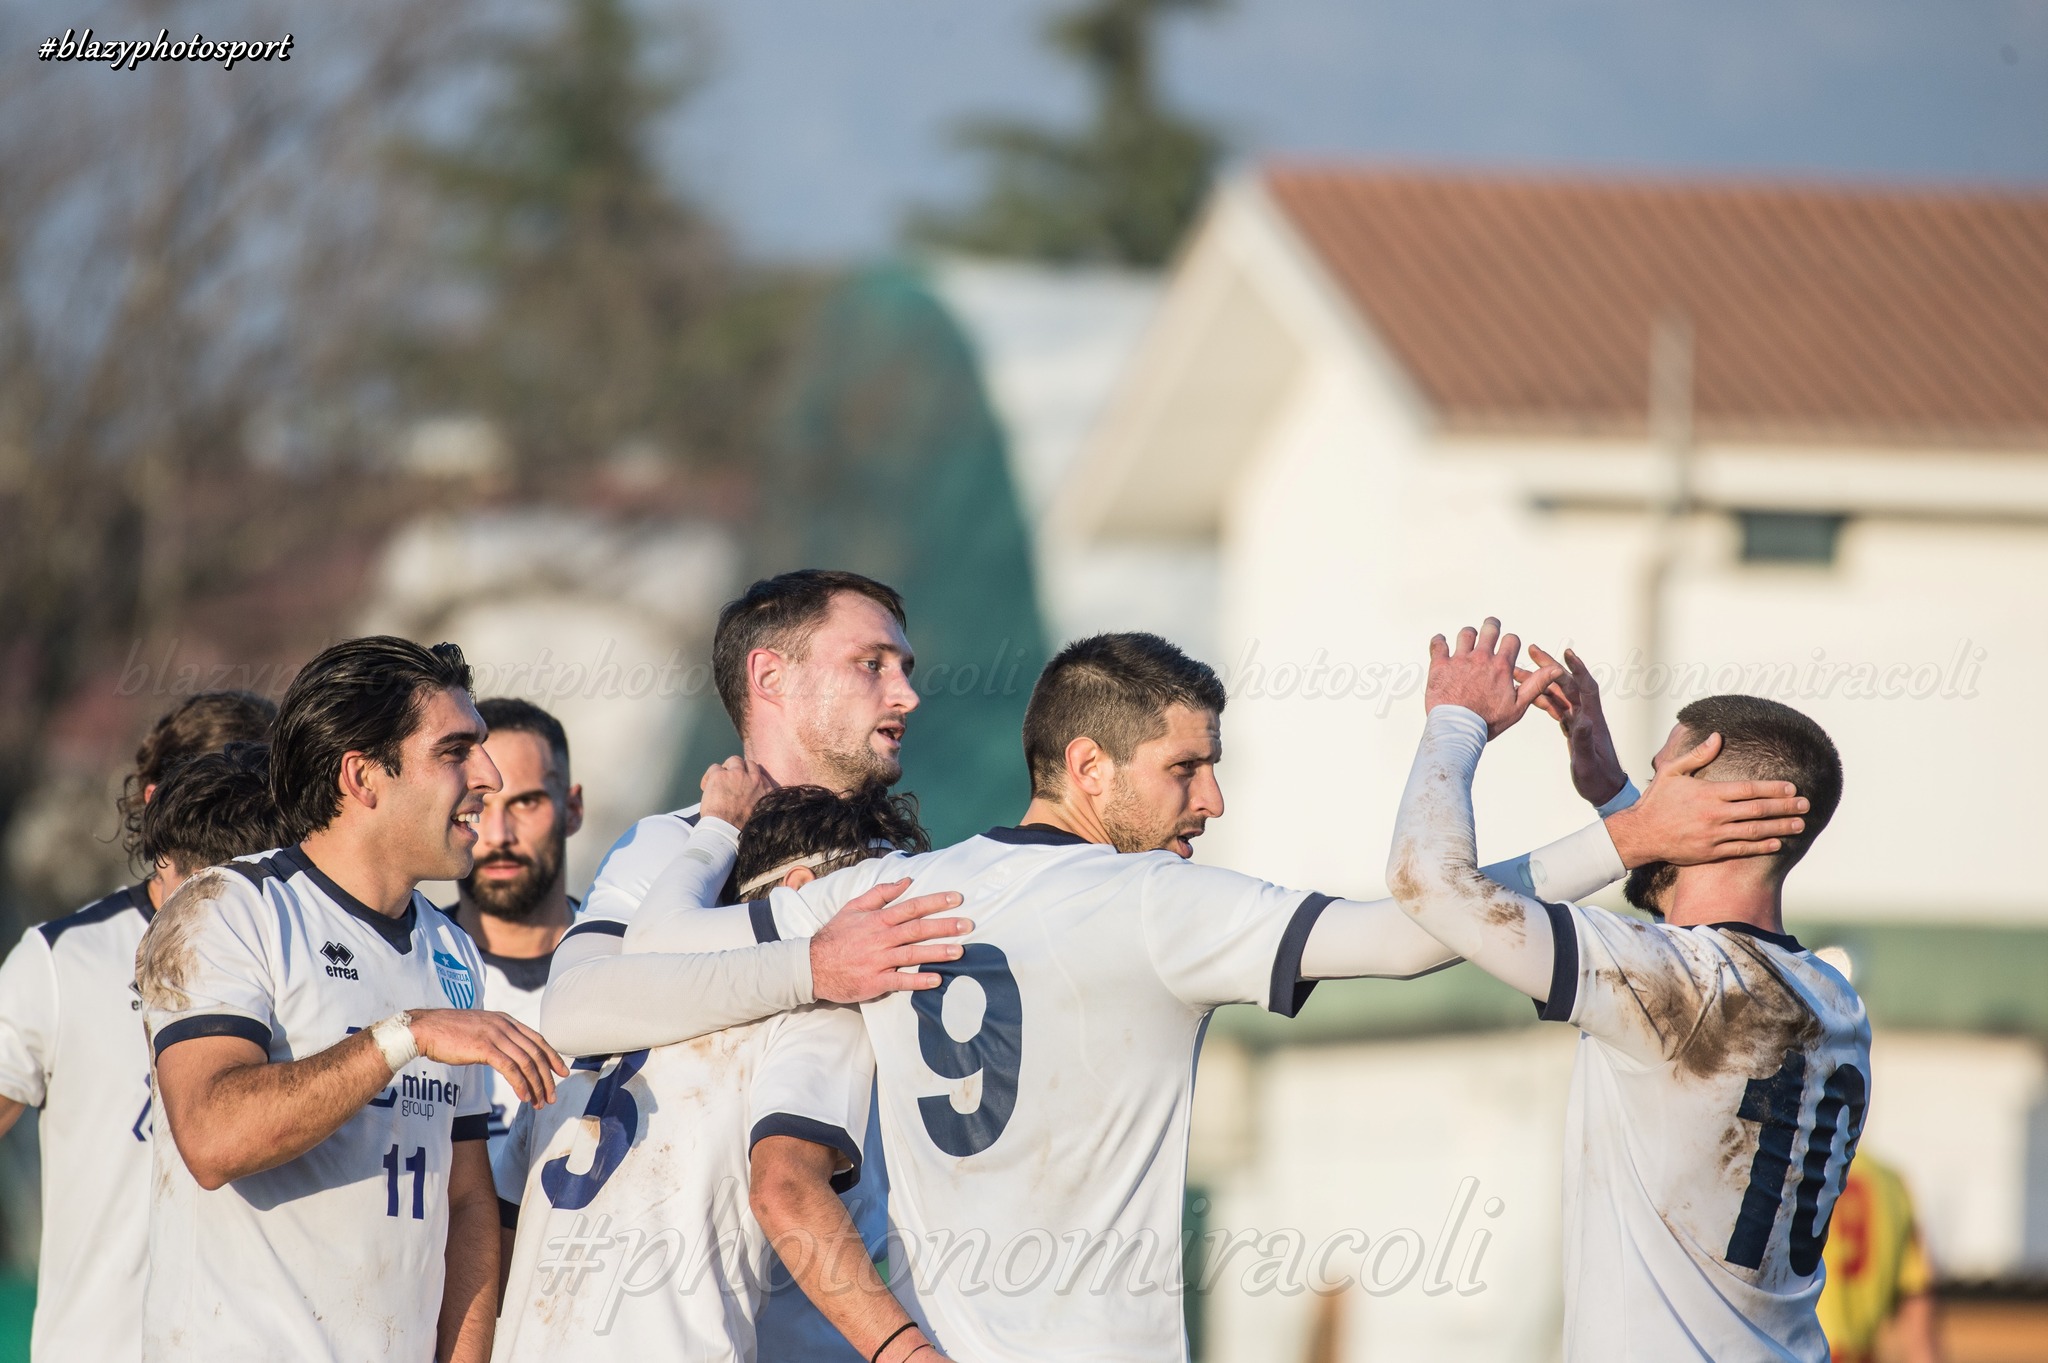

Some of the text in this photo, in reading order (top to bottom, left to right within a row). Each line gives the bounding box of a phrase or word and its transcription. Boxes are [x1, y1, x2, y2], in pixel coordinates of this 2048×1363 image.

[325, 965, 359, 981] errea
[401, 1099, 435, 1121] group
[910, 942, 1023, 1158] 9
[382, 1143, 426, 1220] 11
[540, 1048, 652, 1211] 3
[1725, 1049, 1867, 1278] 10
